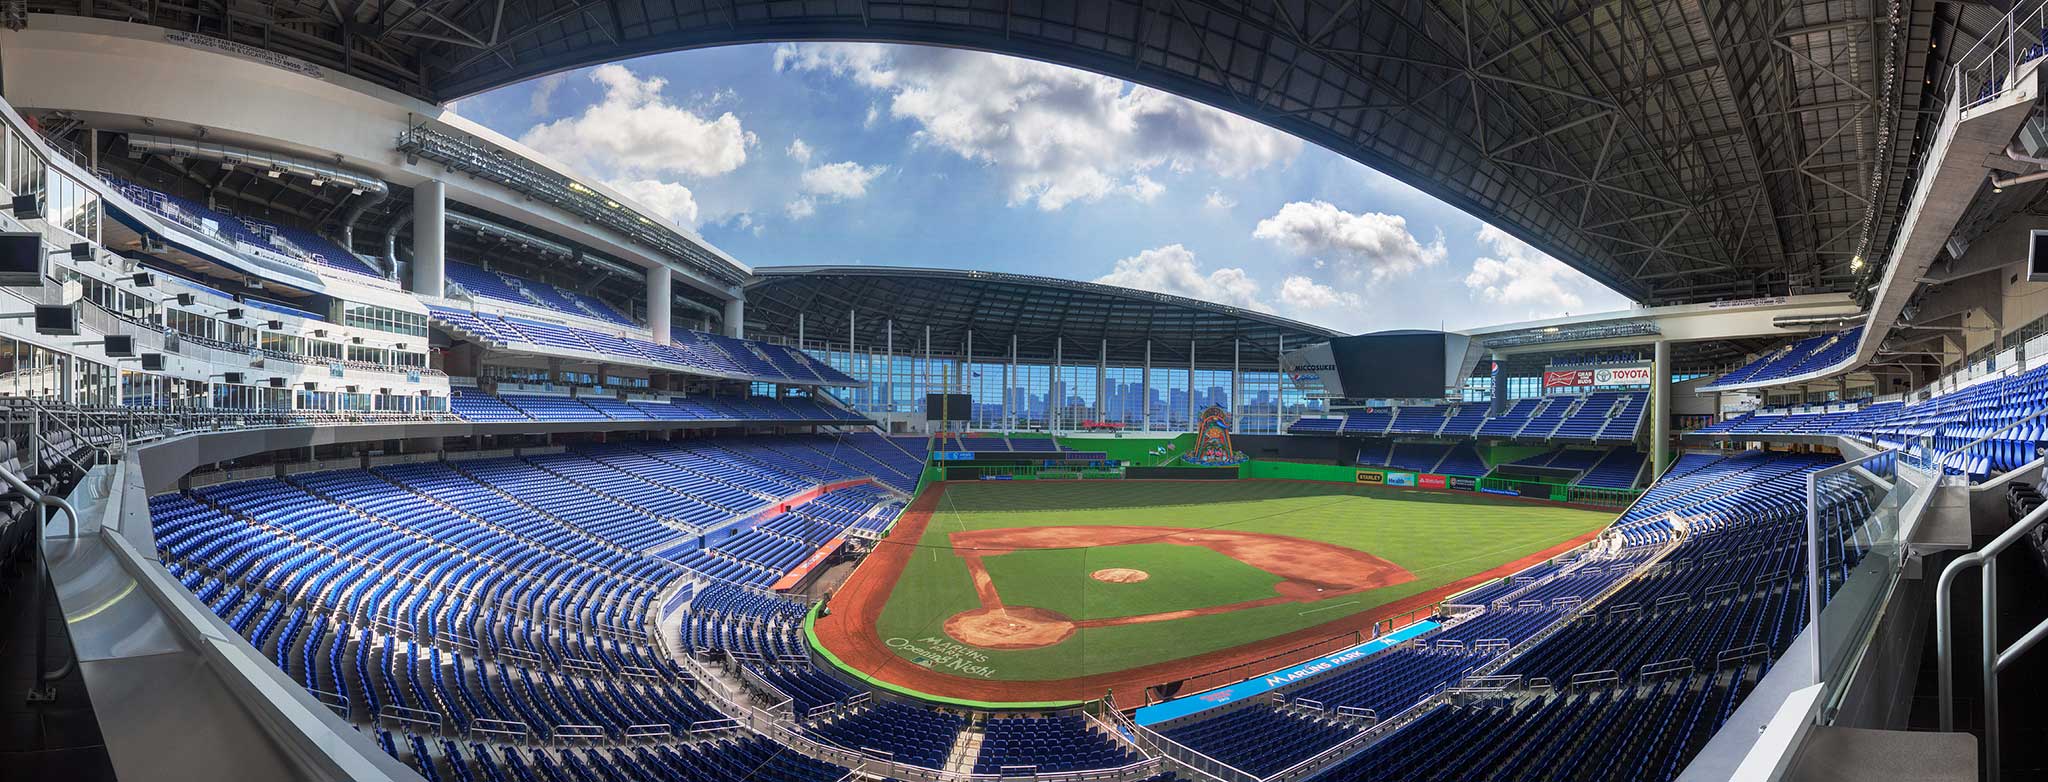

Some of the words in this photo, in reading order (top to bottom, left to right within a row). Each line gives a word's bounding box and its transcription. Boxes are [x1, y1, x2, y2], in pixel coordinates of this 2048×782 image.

[1605, 351, 1637, 363] PARK
[1295, 364, 1336, 372] MICCOSUKEE
[1612, 369, 1649, 379] TOYOTA
[885, 637, 955, 664] Opening
[917, 636, 989, 663] MARLINS
[945, 658, 997, 678] Night
[1265, 662, 1332, 687] MARLINS
[1330, 650, 1366, 665] PARK
